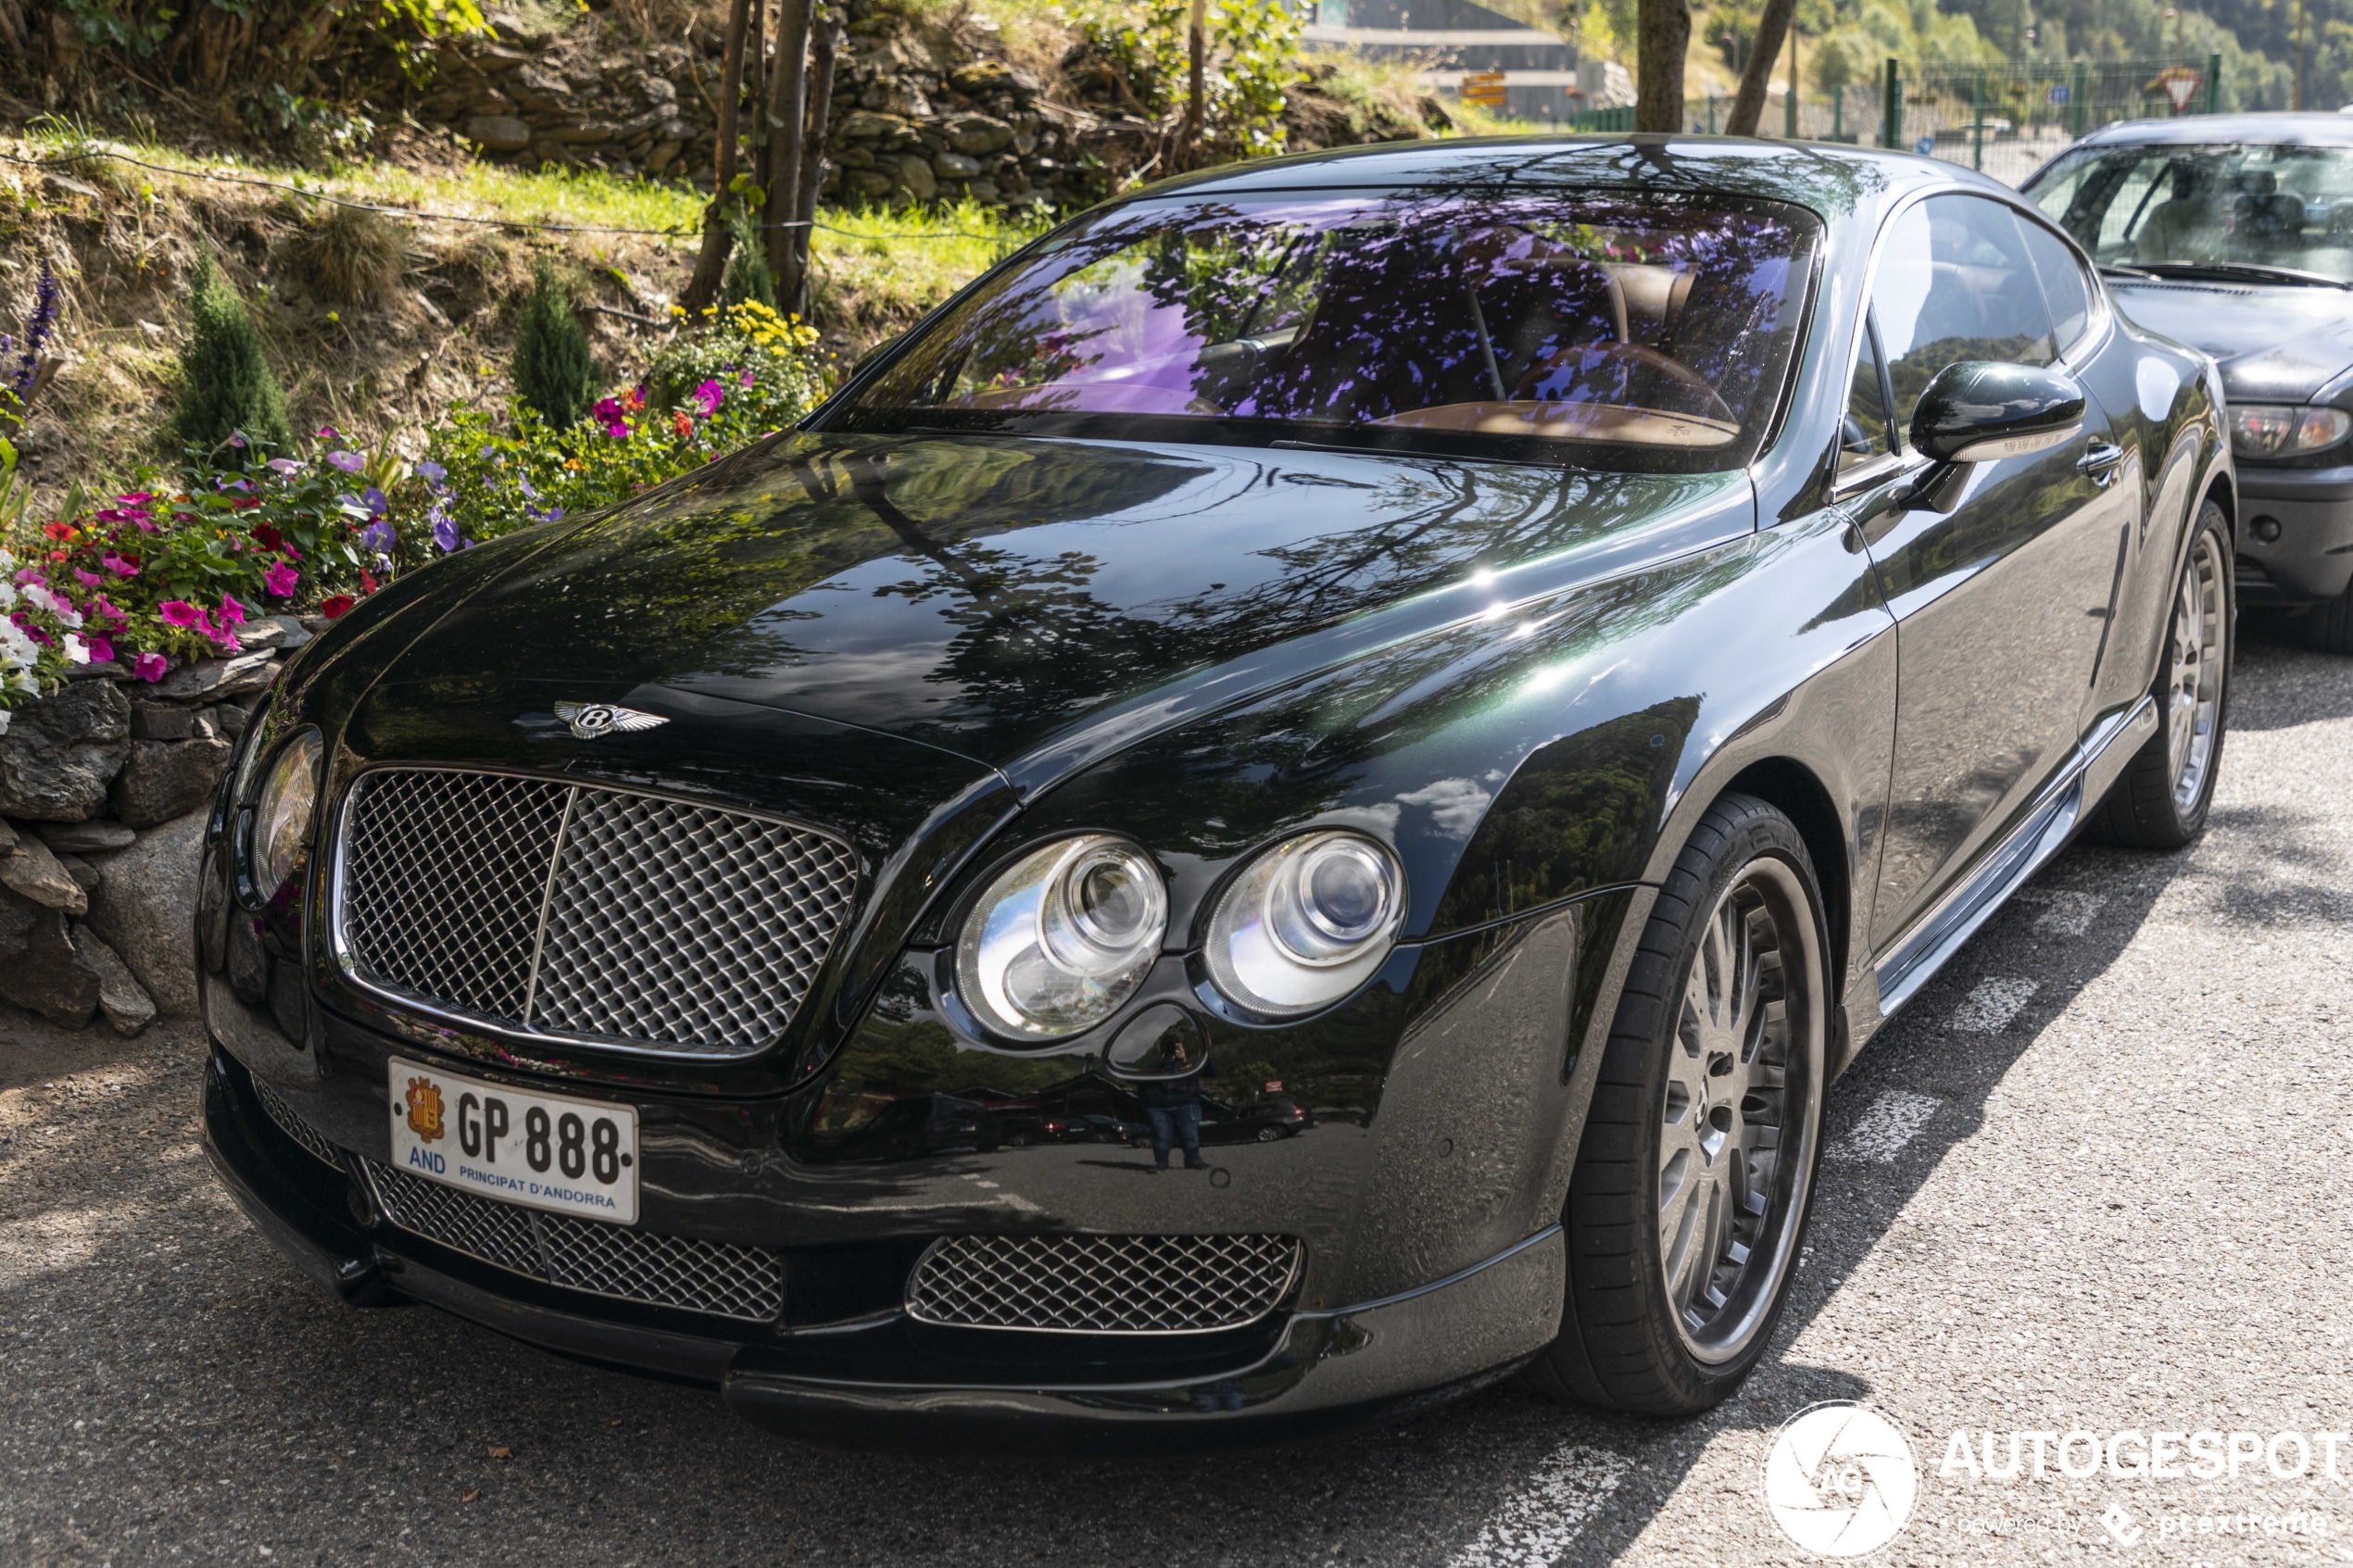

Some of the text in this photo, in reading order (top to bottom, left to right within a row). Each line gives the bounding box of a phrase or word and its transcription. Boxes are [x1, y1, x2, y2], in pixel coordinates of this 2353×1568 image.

[409, 1147, 446, 1174] AND
[459, 1092, 620, 1185] GP 888
[459, 1166, 616, 1210] PRINCIPAT D'ANDORRA
